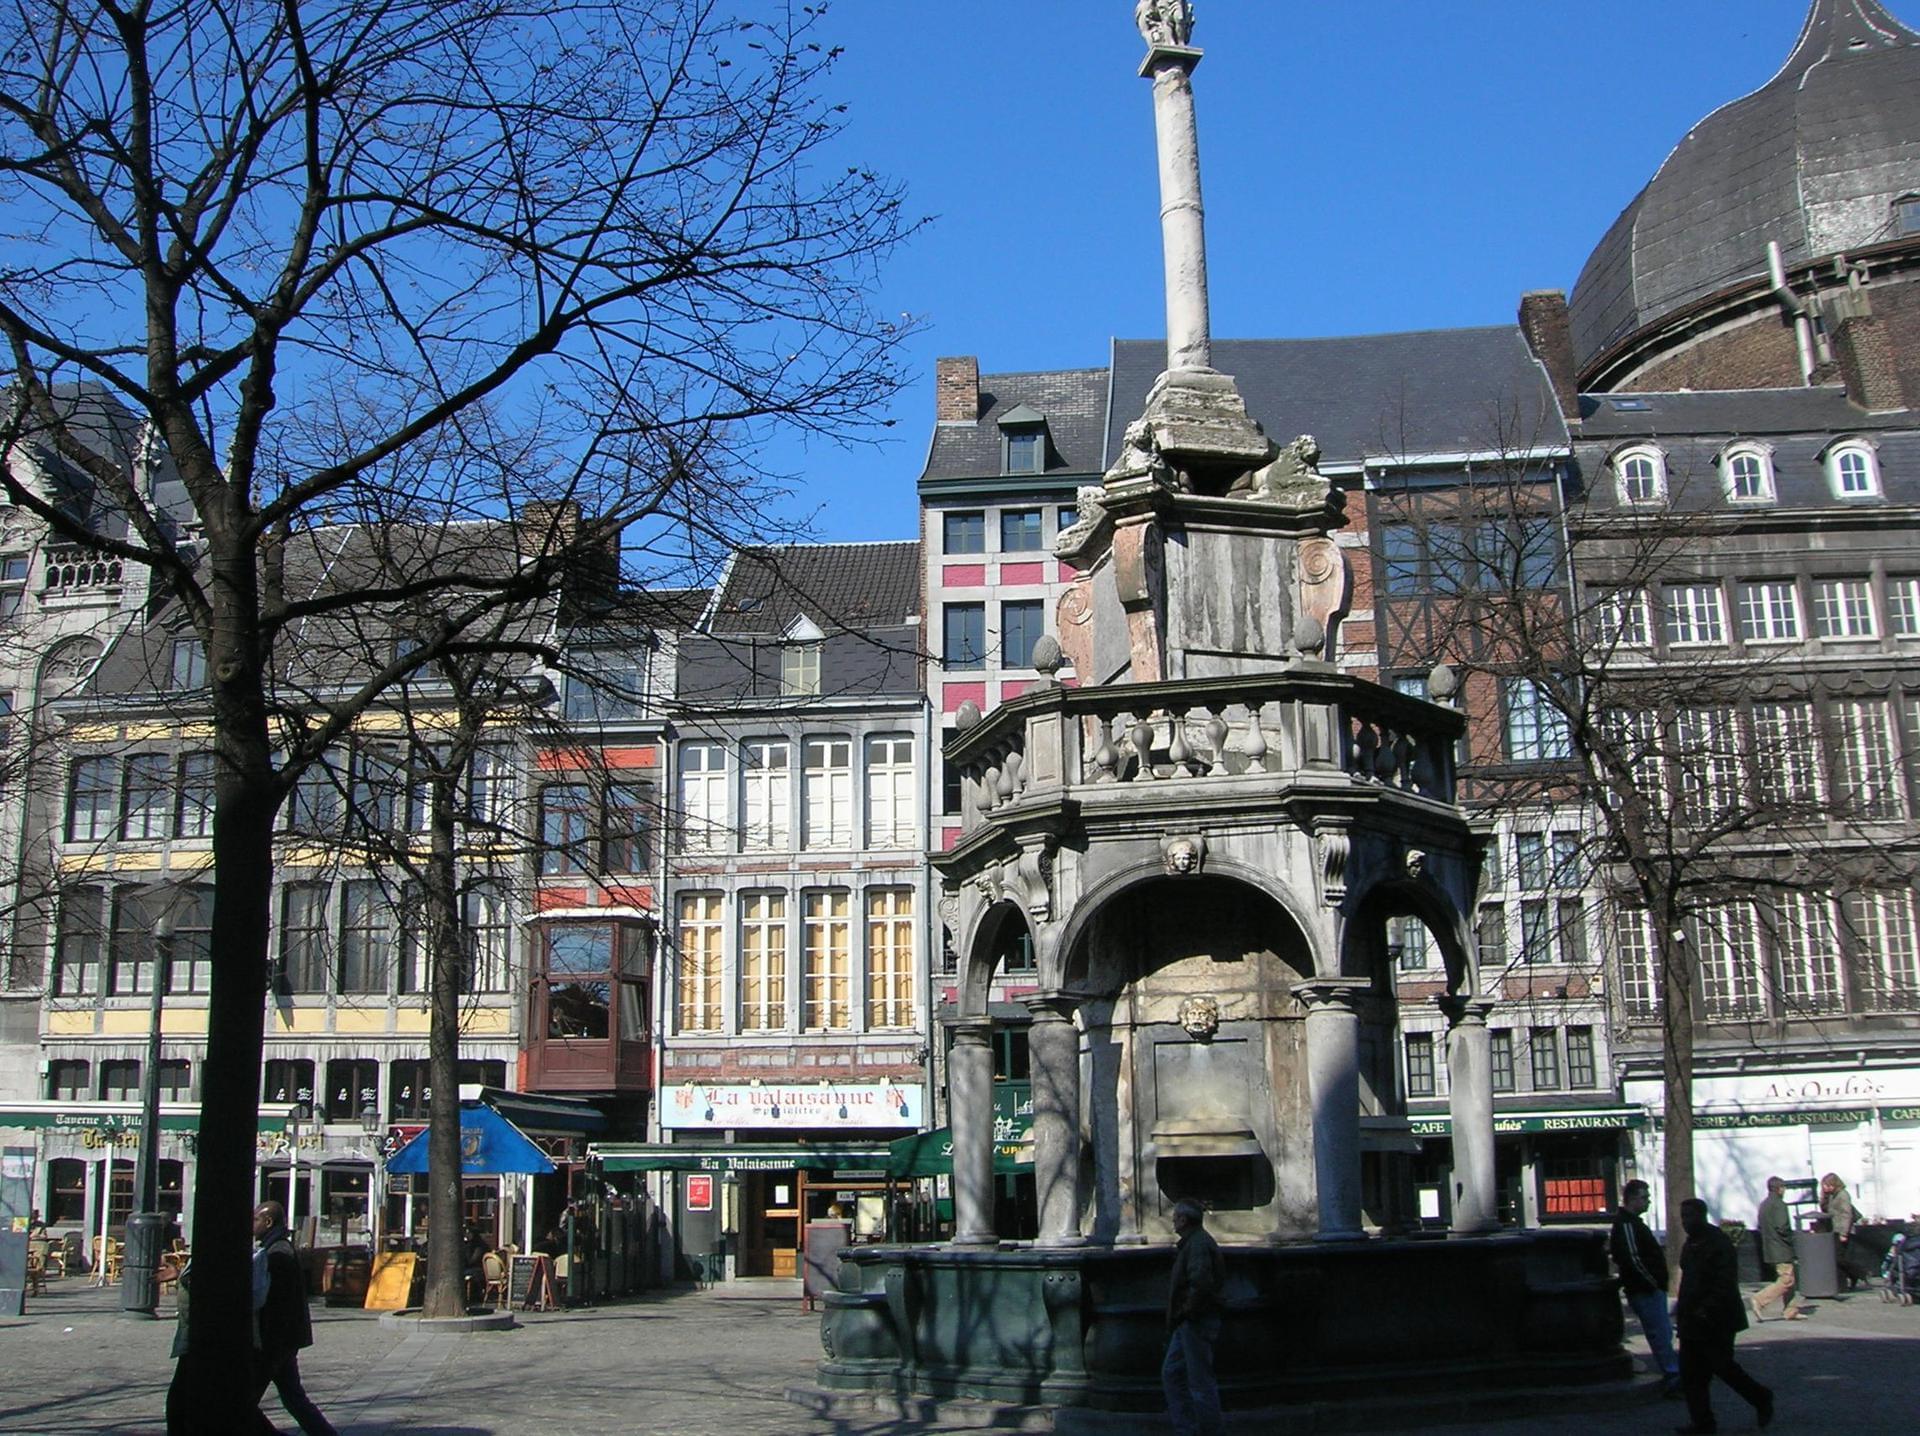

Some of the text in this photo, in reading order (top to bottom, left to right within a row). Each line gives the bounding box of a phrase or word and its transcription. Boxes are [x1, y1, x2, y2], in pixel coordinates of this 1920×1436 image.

[705, 1087, 739, 1106] La
[55, 1114, 100, 1126] Taverne
[1411, 1122, 1446, 1134] CAFE
[1543, 1116, 1629, 1130] RESTAURANT
[700, 1156, 796, 1170] La Valaisanne
